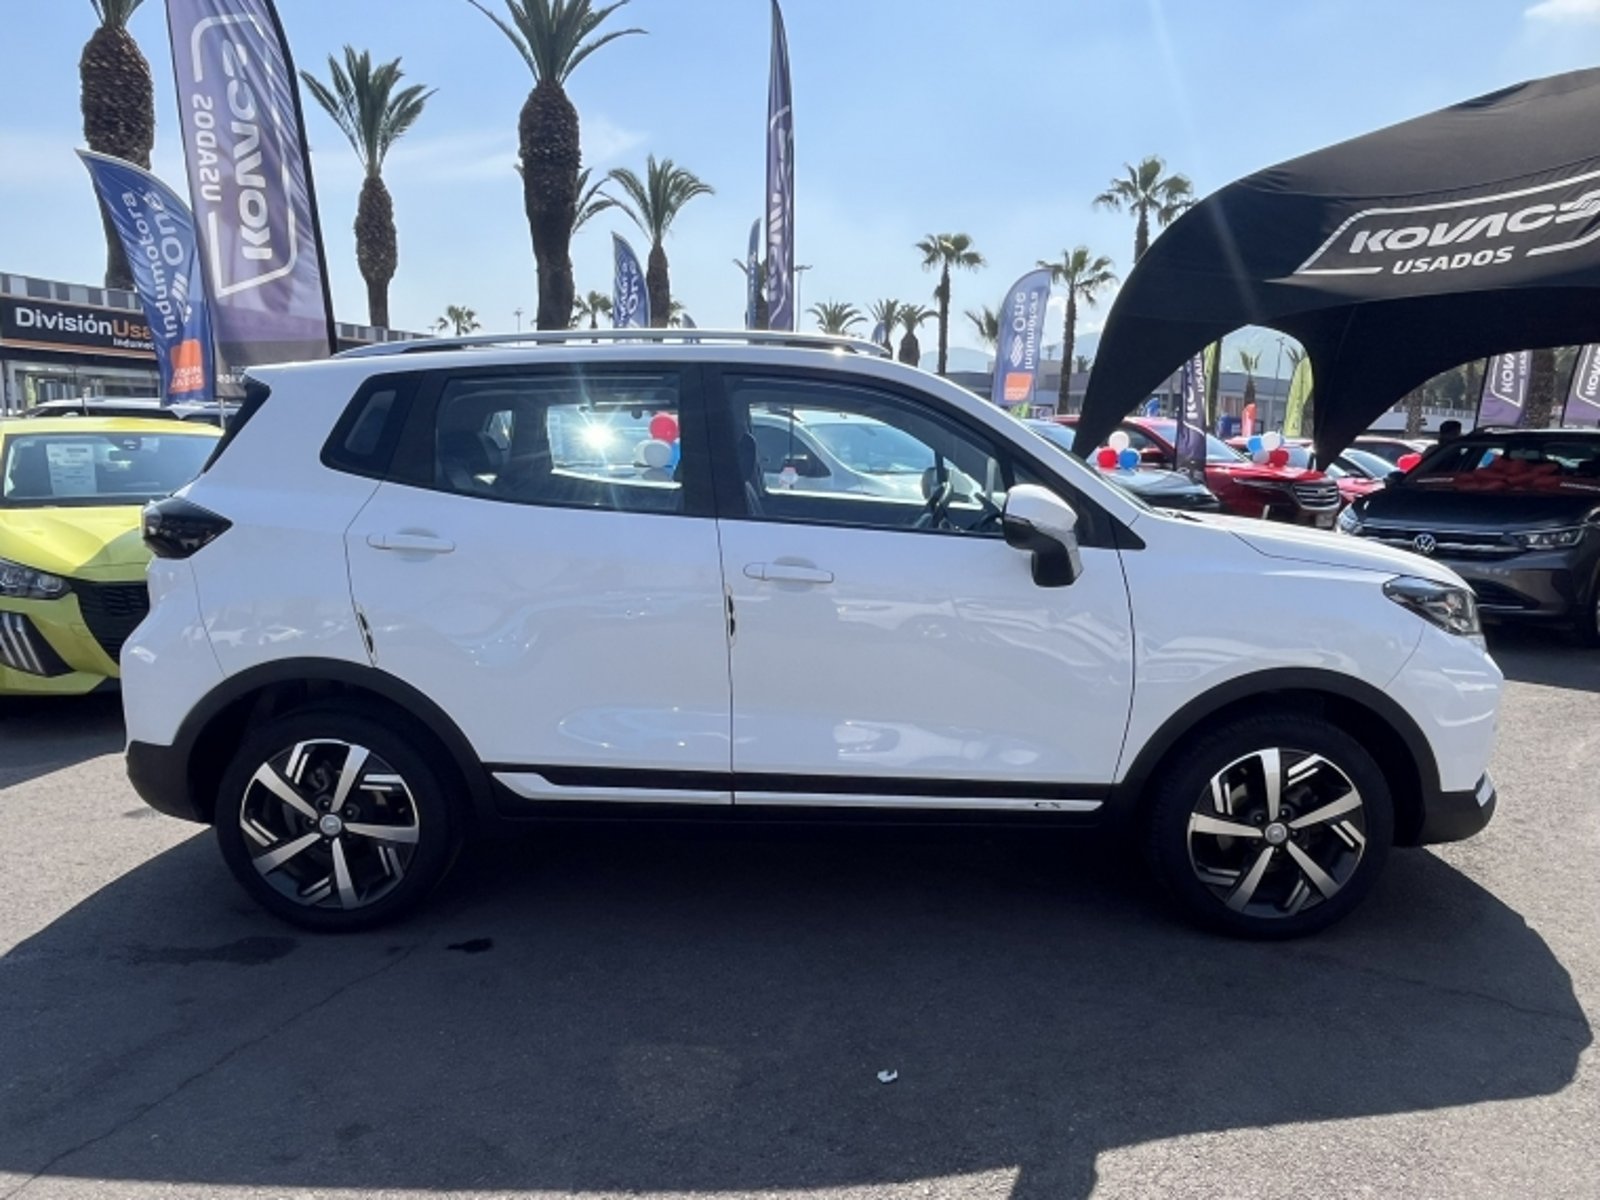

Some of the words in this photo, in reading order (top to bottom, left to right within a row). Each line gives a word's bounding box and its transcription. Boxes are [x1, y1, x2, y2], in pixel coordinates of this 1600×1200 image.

[121, 191, 178, 339] Indumotora
[142, 190, 184, 267] One
[1392, 245, 1516, 275] USADOS
